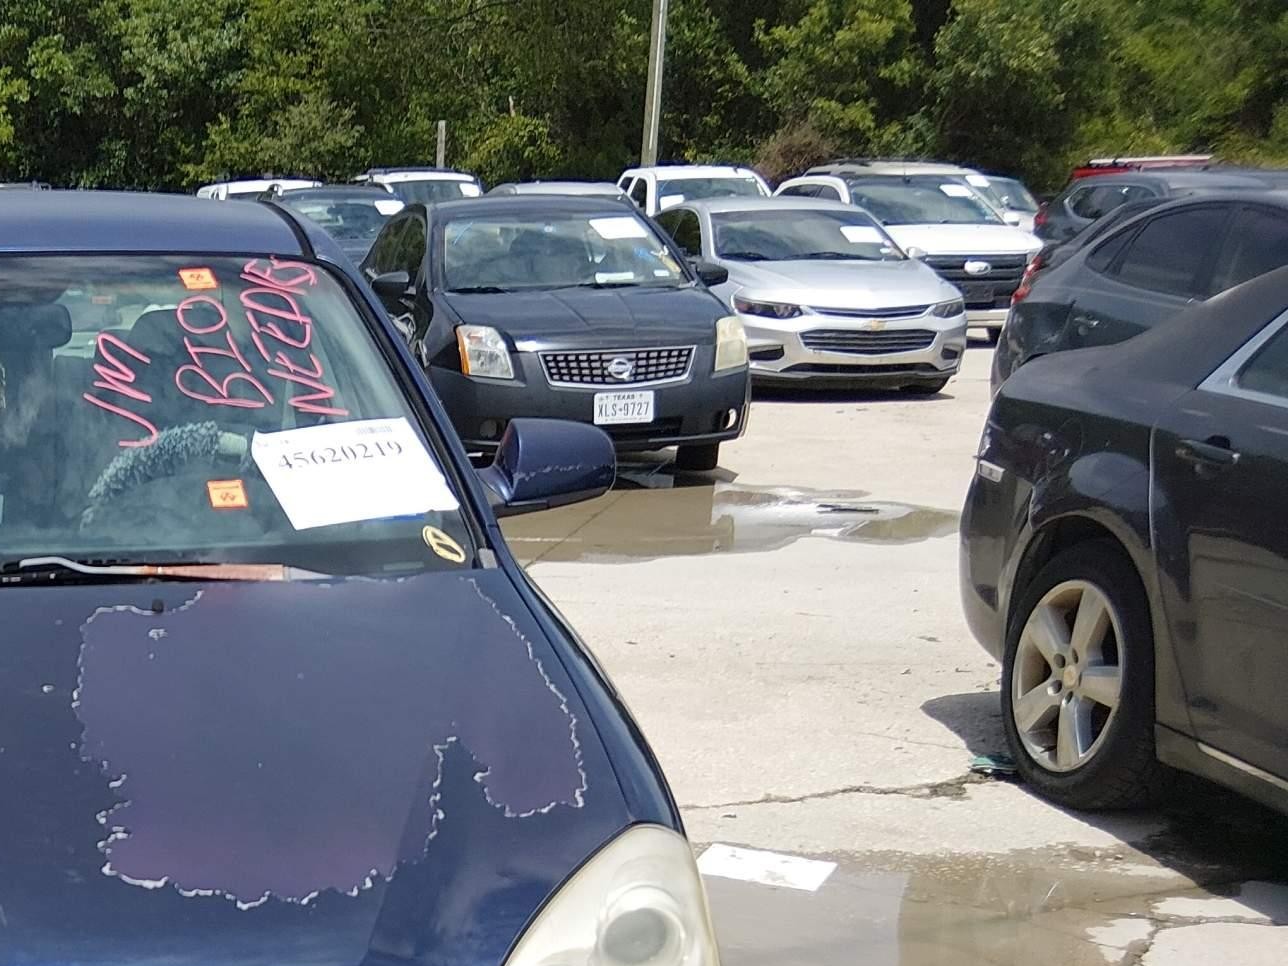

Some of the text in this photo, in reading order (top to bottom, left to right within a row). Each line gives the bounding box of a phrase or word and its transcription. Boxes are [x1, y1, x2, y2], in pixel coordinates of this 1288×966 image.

[175, 295, 274, 408] BIO
[613, 393, 636, 401] TEXAS
[278, 440, 403, 469] 45620219
